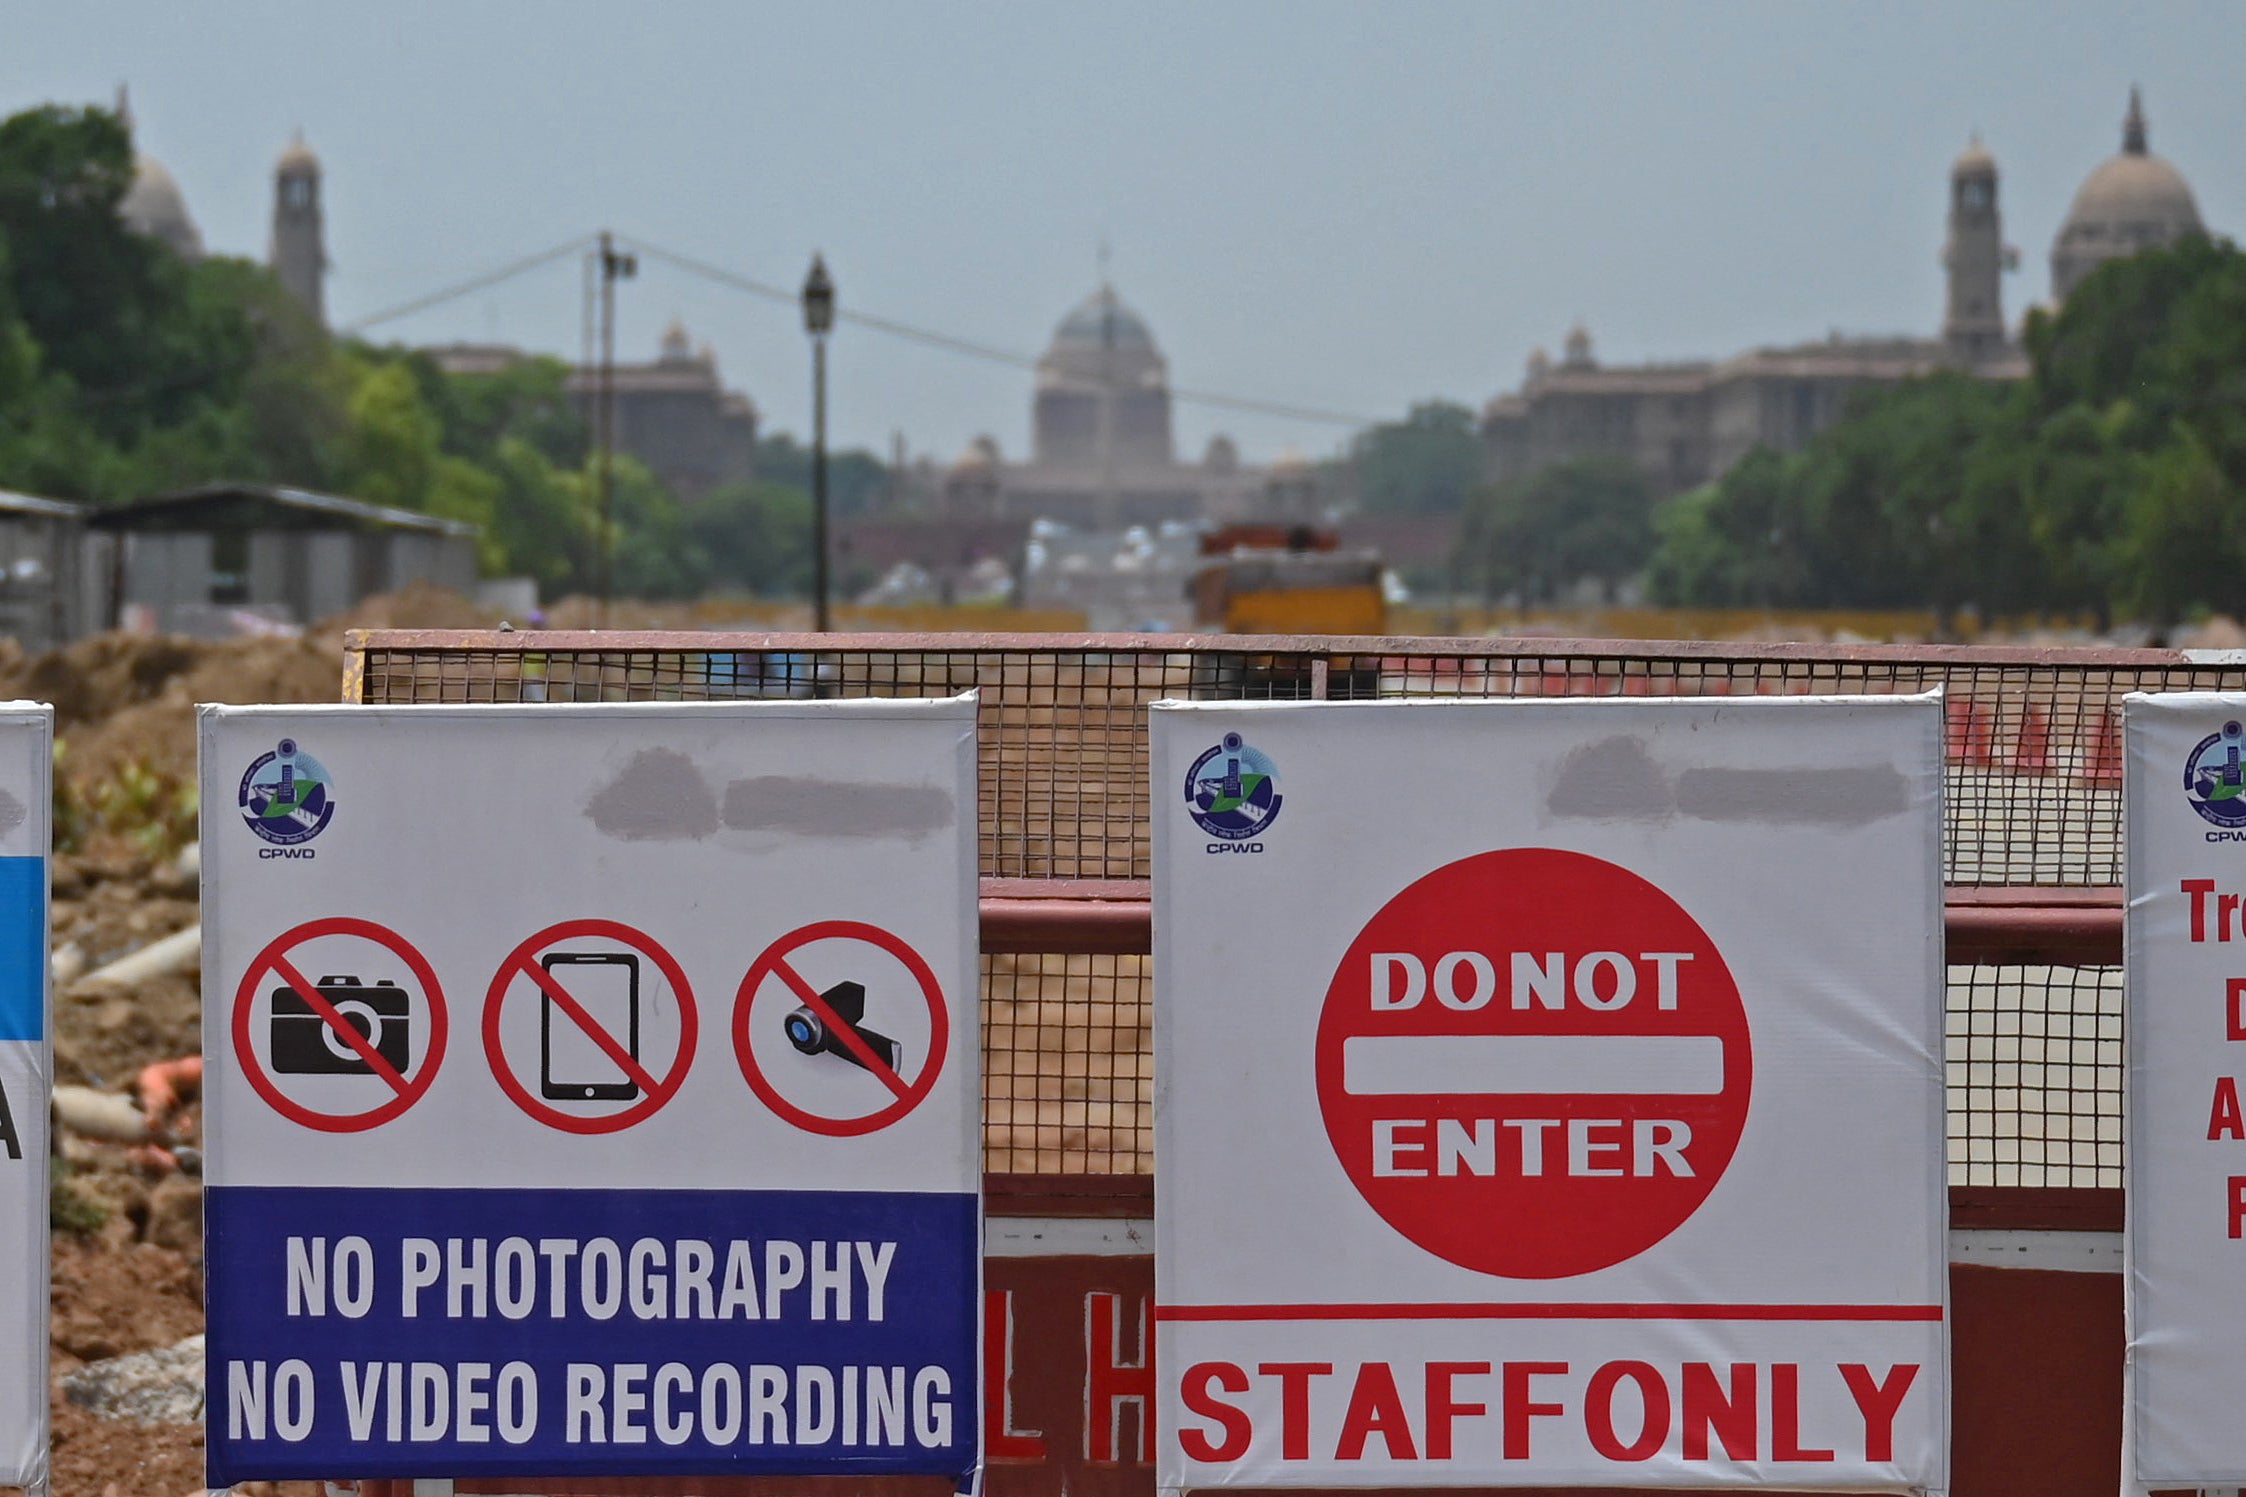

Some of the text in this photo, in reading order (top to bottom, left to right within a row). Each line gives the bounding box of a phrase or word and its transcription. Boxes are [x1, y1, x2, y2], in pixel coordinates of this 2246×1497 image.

[258, 848, 316, 860] CPWD
[1206, 842, 1264, 854] CPWD
[2181, 879, 2246, 943] Tr
[1370, 951, 1694, 1011] DO NOT
[1371, 1118, 1697, 1178] ENTER
[286, 1236, 897, 1322] NO PHOTOGRAPHY
[228, 1358, 953, 1449] NO VIDEO RECORDING
